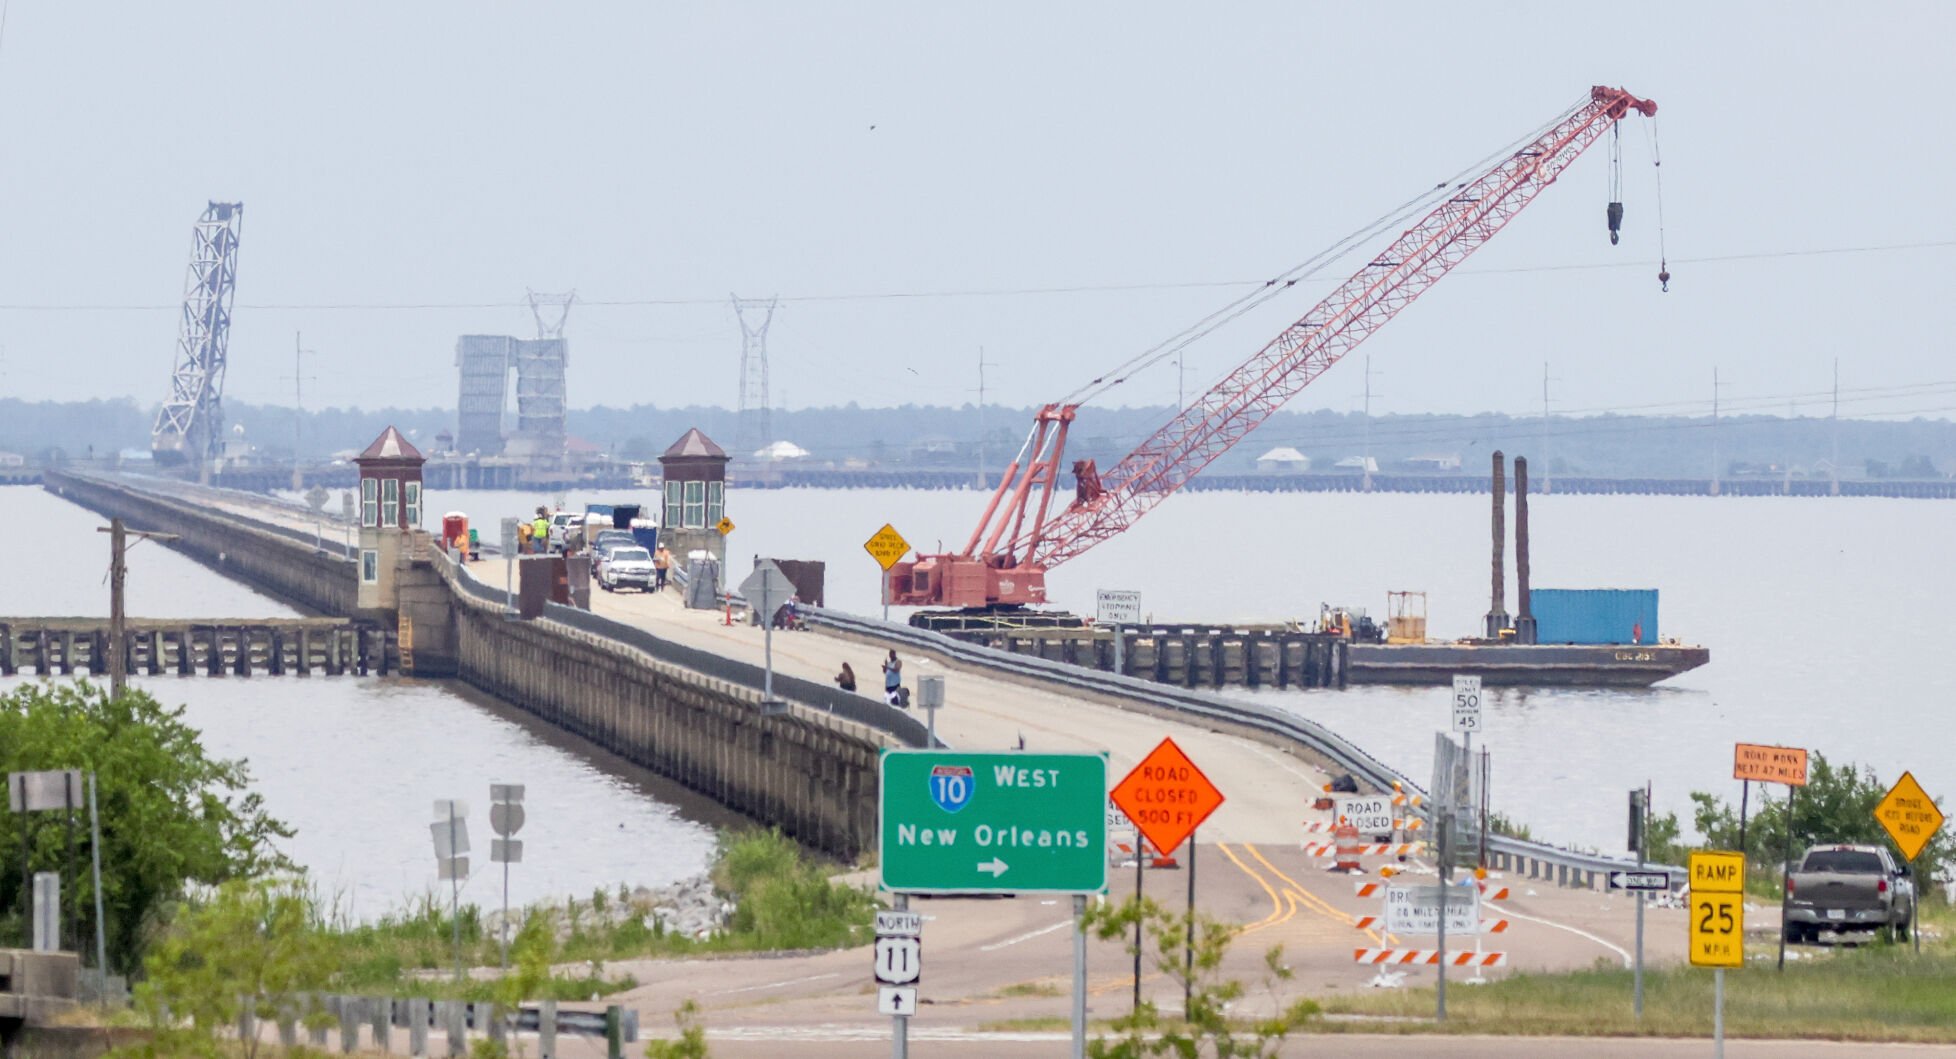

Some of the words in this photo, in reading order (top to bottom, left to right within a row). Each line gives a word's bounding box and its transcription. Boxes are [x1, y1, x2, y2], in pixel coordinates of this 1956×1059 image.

[1457, 694, 1478, 708] 50
[1459, 716, 1476, 728] 45
[1743, 750, 1768, 761] ROAD
[1773, 754, 1798, 765] WORK
[993, 765, 1060, 788] WEST
[1143, 766, 1189, 781] ROAD
[938, 776, 966, 804] 10
[1135, 787, 1198, 804] CLOSED
[1347, 801, 1382, 815] ROAD
[1138, 809, 1170, 825] 500
[1176, 811, 1194, 825] FT
[1344, 816, 1389, 829] LOSED
[898, 823, 957, 846] New
[974, 824, 1089, 848] Orleans
[1696, 864, 1736, 881] RAMP
[877, 916, 919, 930] NORTH
[1699, 902, 1733, 934] 25
[887, 947, 907, 971] 11
